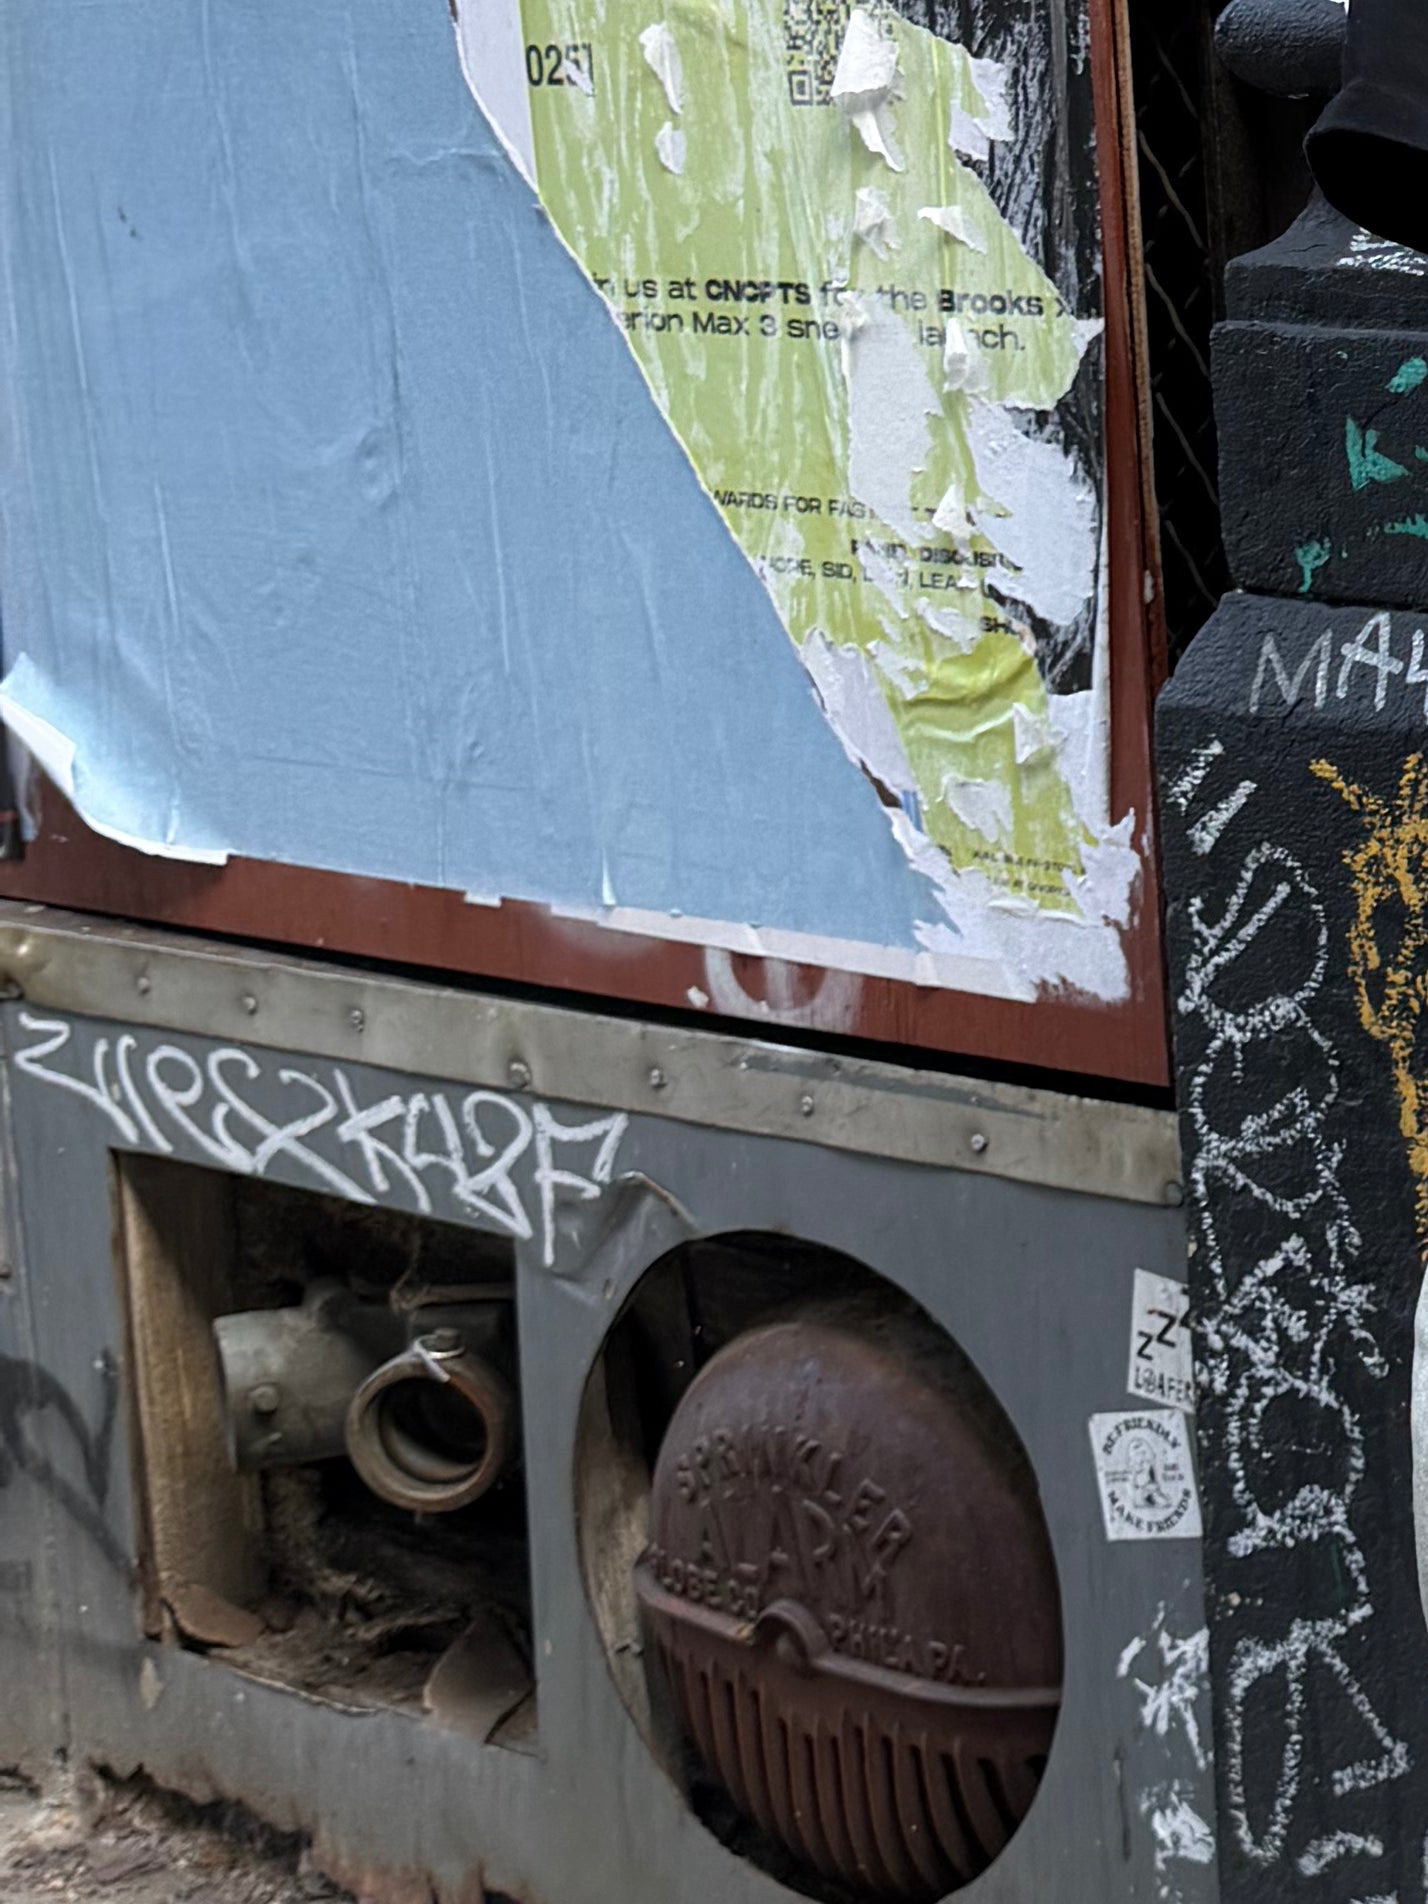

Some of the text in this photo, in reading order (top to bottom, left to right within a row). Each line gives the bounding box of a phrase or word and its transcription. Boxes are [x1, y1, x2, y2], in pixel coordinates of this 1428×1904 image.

[624, 277, 658, 298] us
[667, 277, 699, 300] at
[704, 278, 812, 306] CNCPTS
[937, 288, 1045, 317] Brooks
[692, 311, 750, 337] Max
[759, 314, 779, 338] 3
[783, 495, 822, 515] FOR
